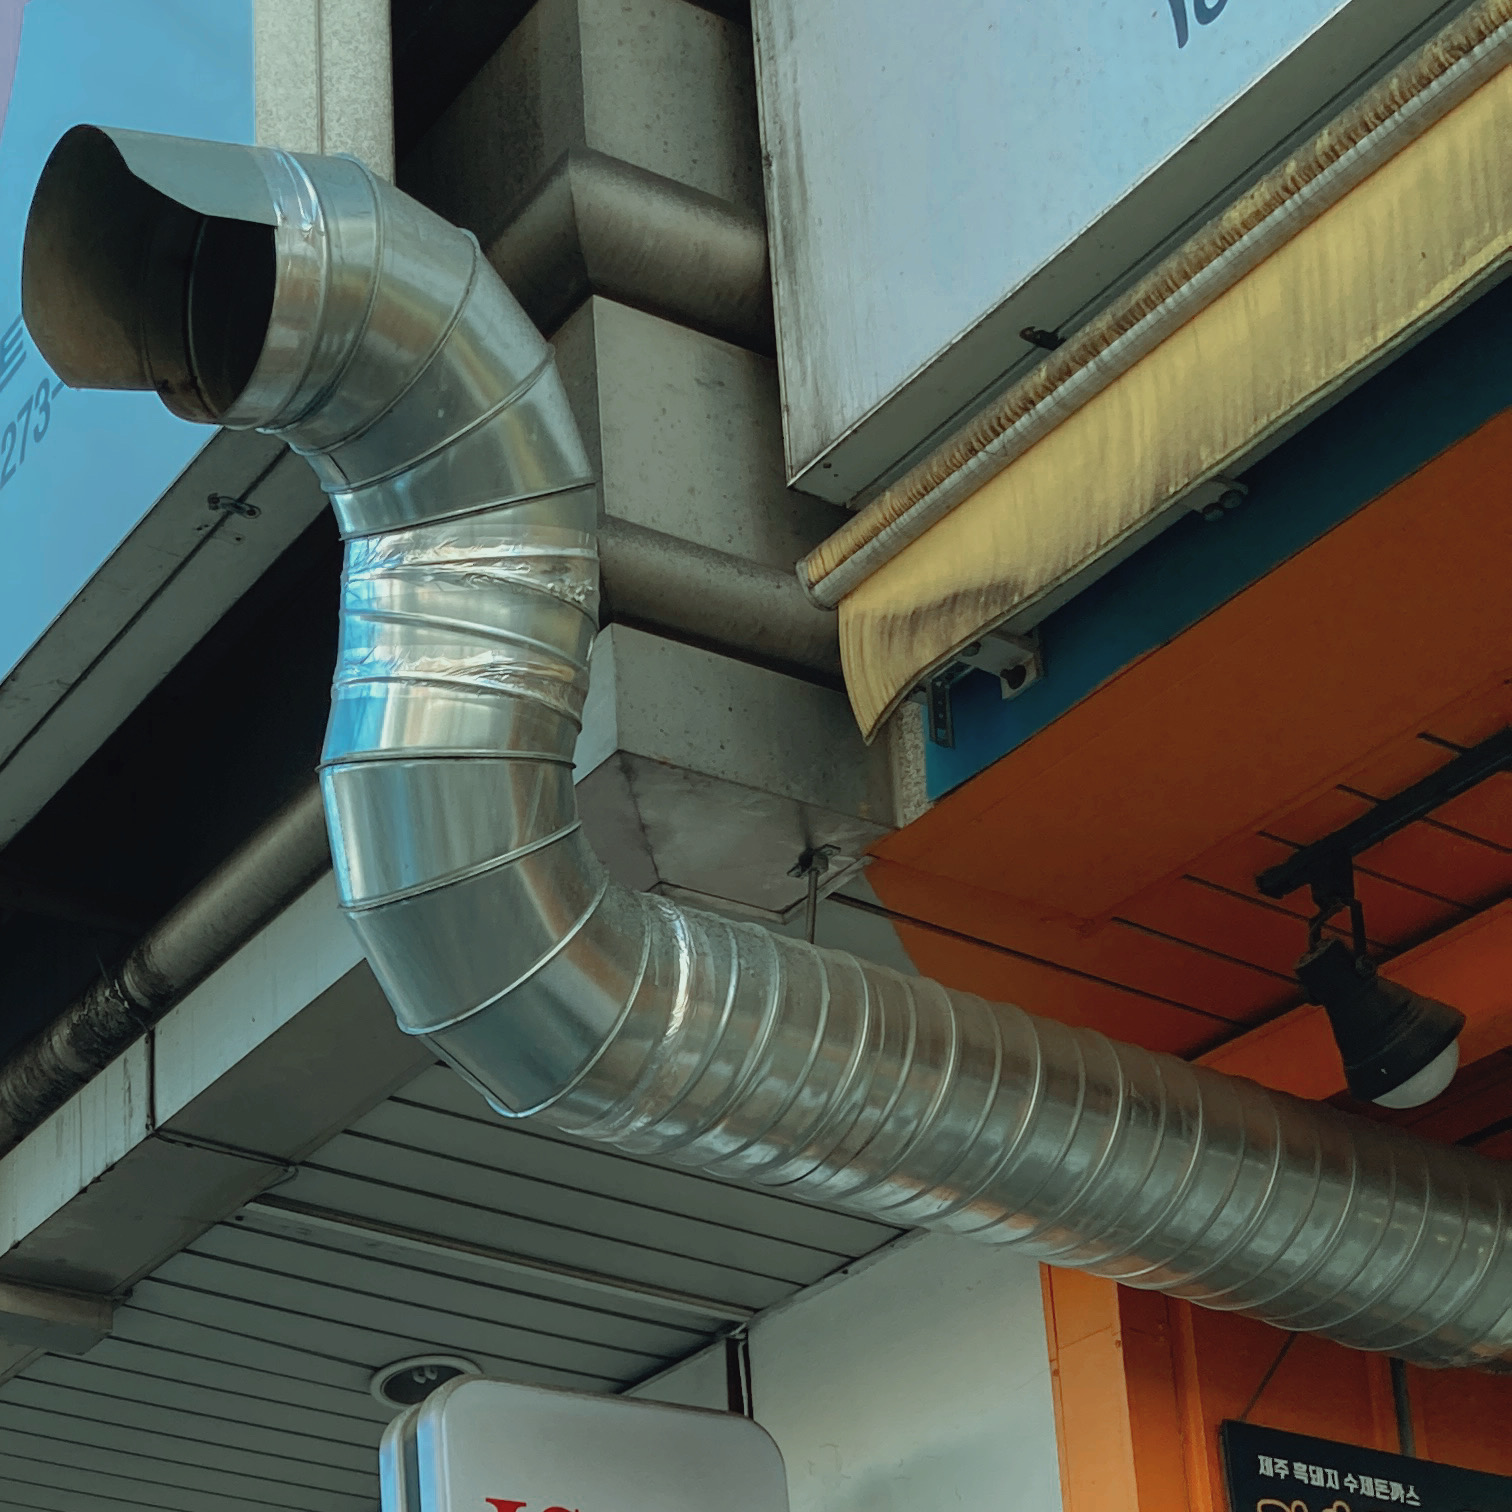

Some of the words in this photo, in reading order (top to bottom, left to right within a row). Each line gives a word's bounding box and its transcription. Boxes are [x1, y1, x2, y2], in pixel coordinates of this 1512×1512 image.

[1257, 1454, 1289, 1480] 제주
[1292, 1461, 1340, 1491] 흑돼지
[1343, 1472, 1422, 1507] 수제돈까스
